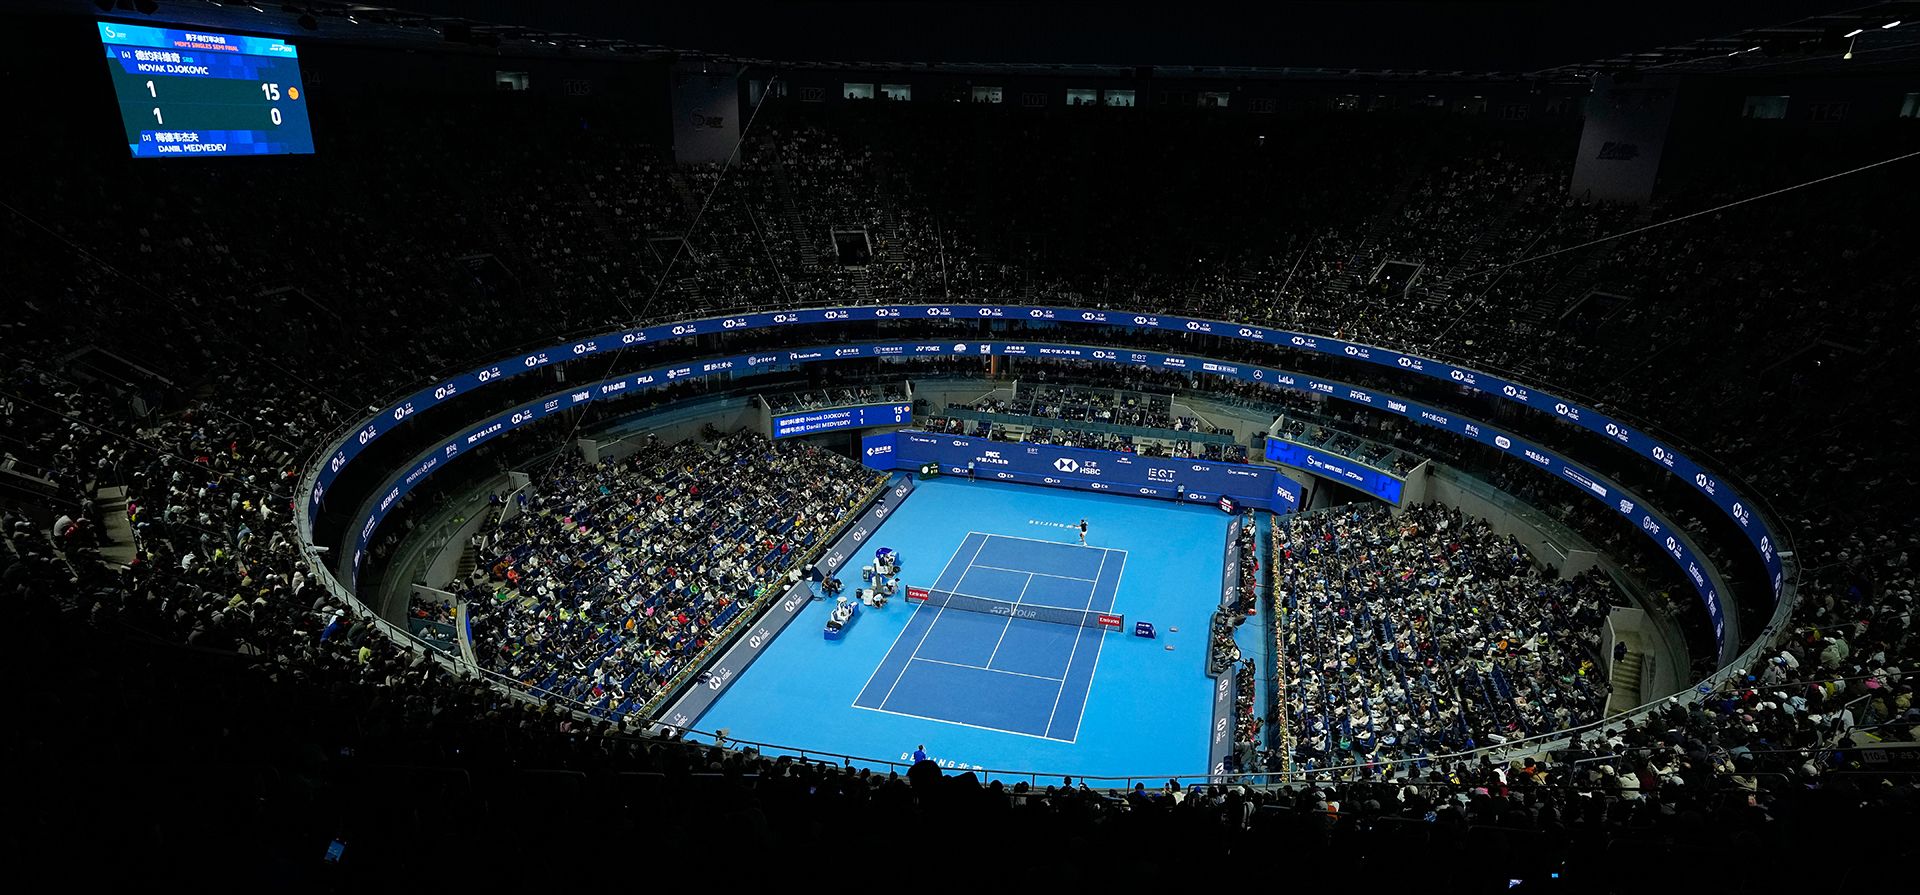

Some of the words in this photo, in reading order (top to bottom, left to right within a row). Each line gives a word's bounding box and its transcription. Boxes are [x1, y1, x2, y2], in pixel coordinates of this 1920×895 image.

[138, 64, 166, 73] NOVAK
[168, 65, 209, 75] DJOKOVIC
[147, 80, 156, 97] 1
[261, 83, 280, 101] 15
[153, 107, 163, 125] 1
[270, 108, 282, 125] 0
[184, 144, 226, 152] MEDVEDEV
[637, 375, 653, 385] FILA
[822, 420, 850, 428] MEDVEDEV
[1080, 467, 1100, 476] HSBC
[1148, 468, 1176, 479] EQT
[990, 606, 1010, 614] ATP
[1012, 610, 1036, 619] TOUR
